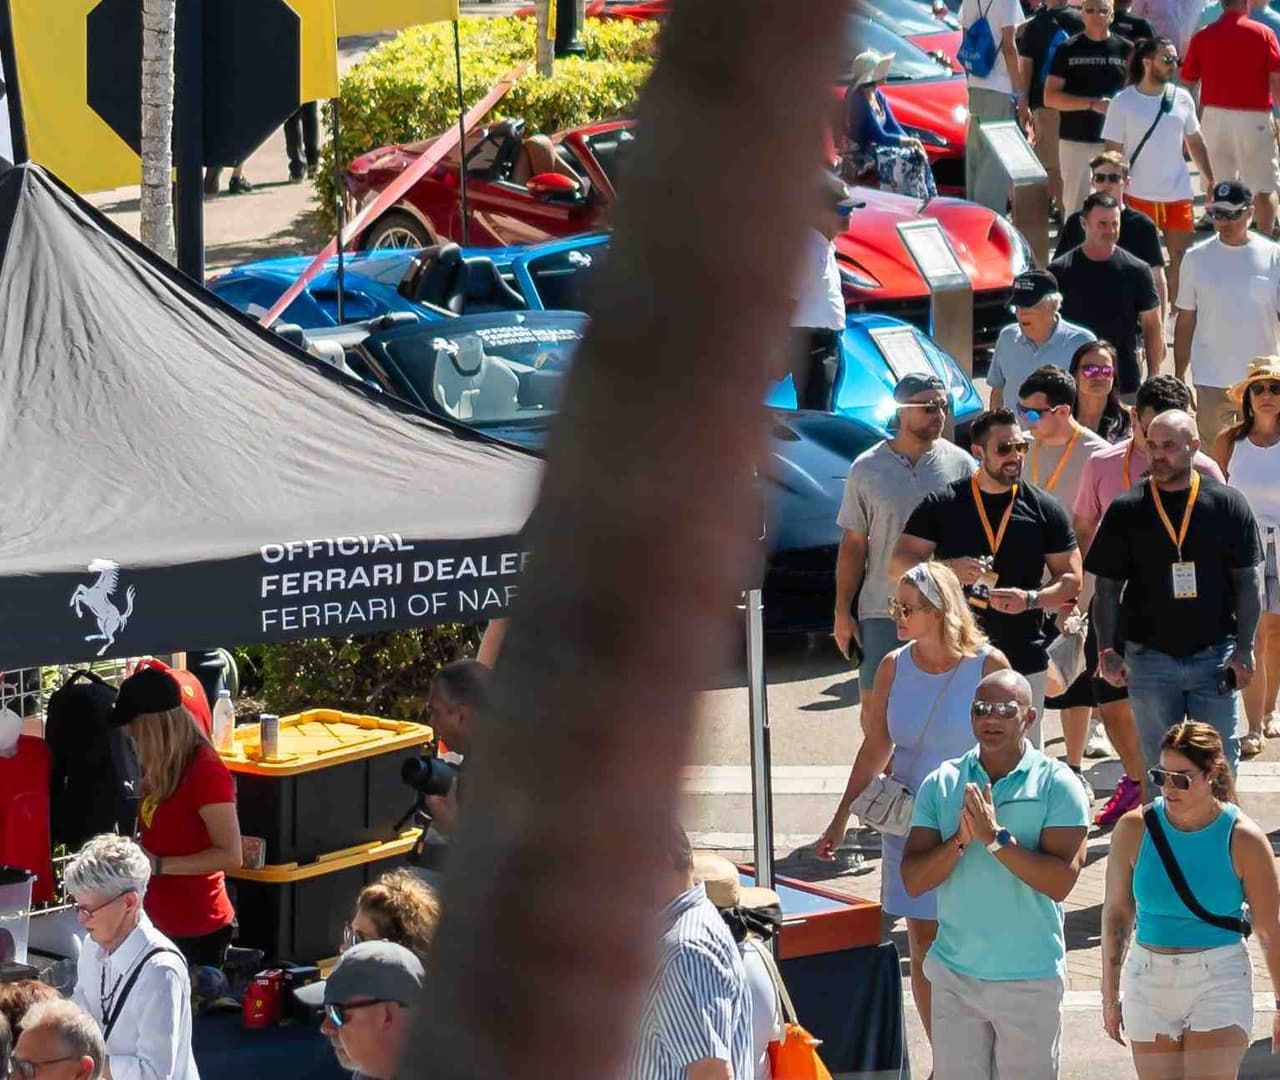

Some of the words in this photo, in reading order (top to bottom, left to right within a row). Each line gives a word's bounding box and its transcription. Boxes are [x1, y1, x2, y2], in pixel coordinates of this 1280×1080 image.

[259, 532, 415, 564] OFFICIAL
[260, 562, 403, 598] FERRARI
[261, 596, 397, 633] FERRARI
[407, 591, 449, 617] OF
